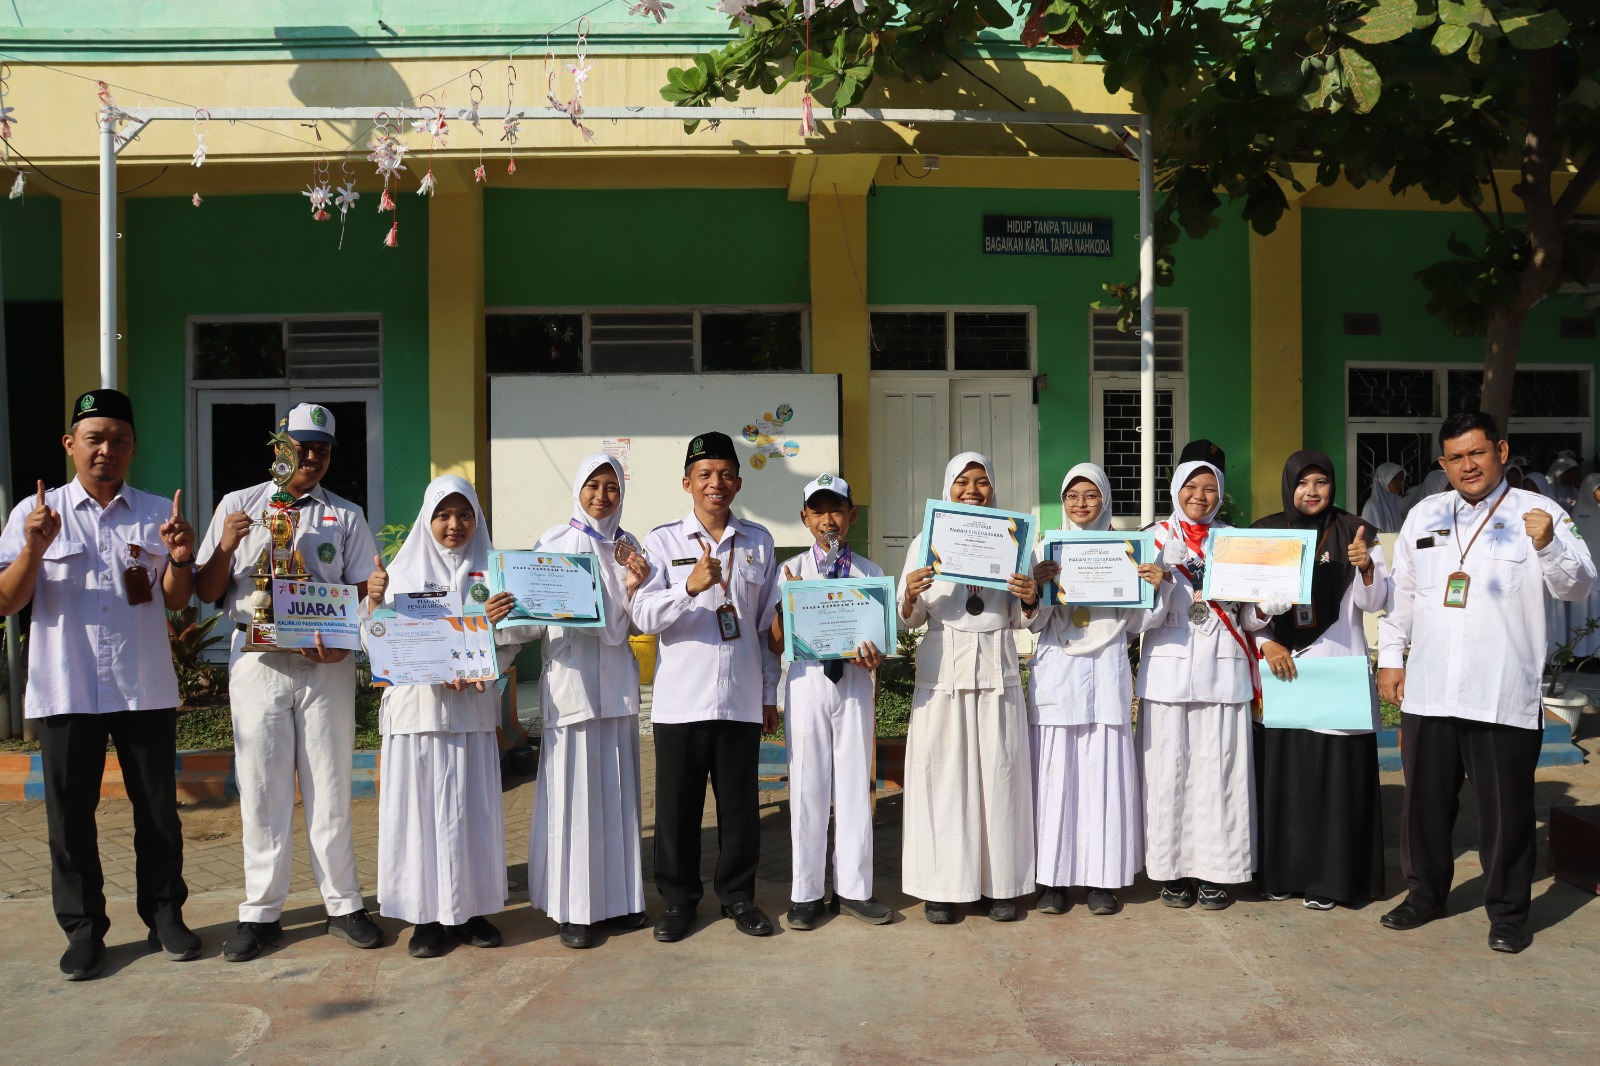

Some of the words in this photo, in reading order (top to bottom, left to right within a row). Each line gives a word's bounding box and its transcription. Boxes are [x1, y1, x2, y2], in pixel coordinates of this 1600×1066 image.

[1007, 220, 1032, 234] HIDUP
[1034, 220, 1060, 235] TANPA
[1061, 221, 1093, 235] TUJUAN
[985, 236, 1024, 252] BAGAIKAN
[1025, 237, 1050, 253] KAPAL
[1050, 238, 1074, 254] TANPA
[1075, 239, 1111, 254] NAHKODA
[287, 602, 337, 616] JUARA
[339, 603, 347, 617] 1
[407, 602, 451, 610] PENGHARGAAN
[324, 621, 348, 629] KARNAVAL
